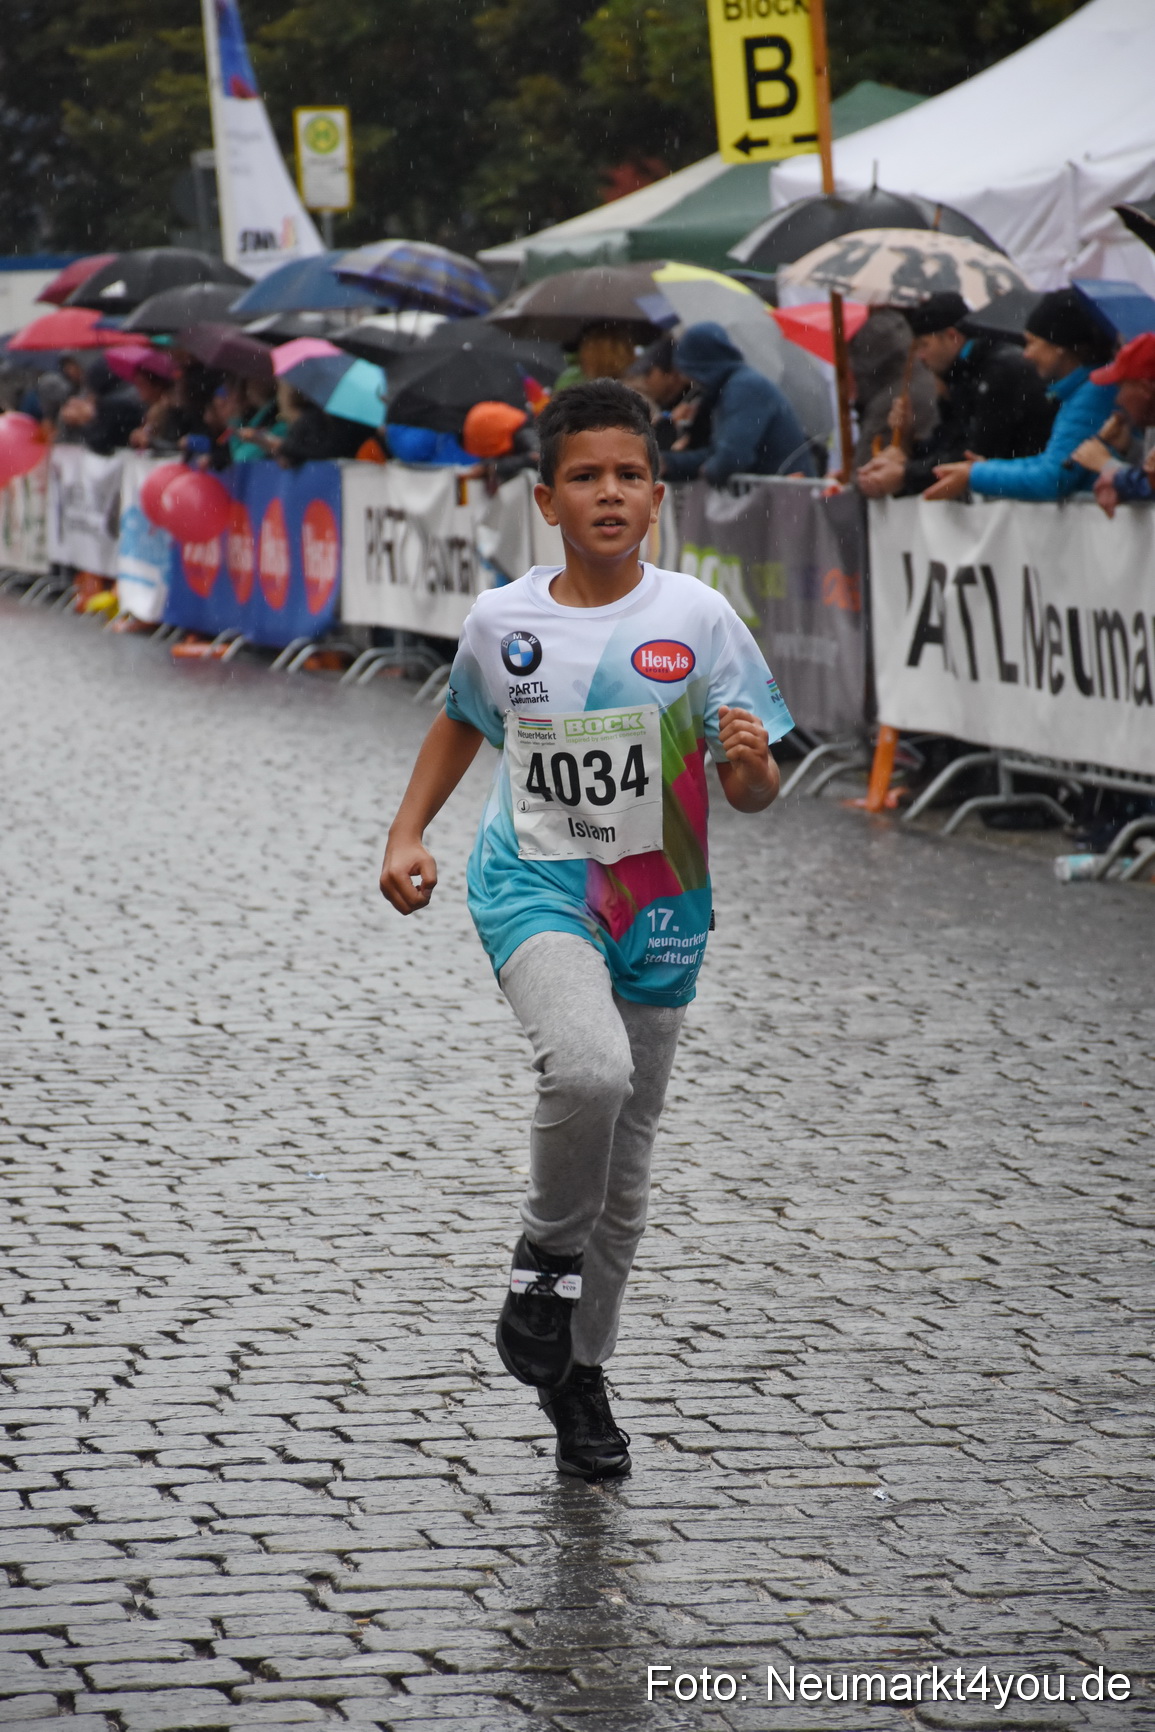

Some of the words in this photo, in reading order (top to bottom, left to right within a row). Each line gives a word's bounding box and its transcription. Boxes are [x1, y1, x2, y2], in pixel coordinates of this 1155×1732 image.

[724, 0, 810, 21] Block
[744, 34, 798, 120] B
[502, 633, 537, 648] BMW
[1023, 564, 1155, 706] Neuma
[641, 650, 689, 672] Hervis
[509, 681, 548, 698] PARTL
[510, 694, 549, 706] Neumarkt
[564, 712, 645, 735] BOCK
[517, 730, 557, 740] NeuerMarkt
[526, 744, 649, 806] 4034
[568, 817, 616, 842] Islam
[647, 908, 679, 932] 17.
[648, 931, 707, 949] Neumarkter
[644, 950, 698, 965] Stadtlauf
